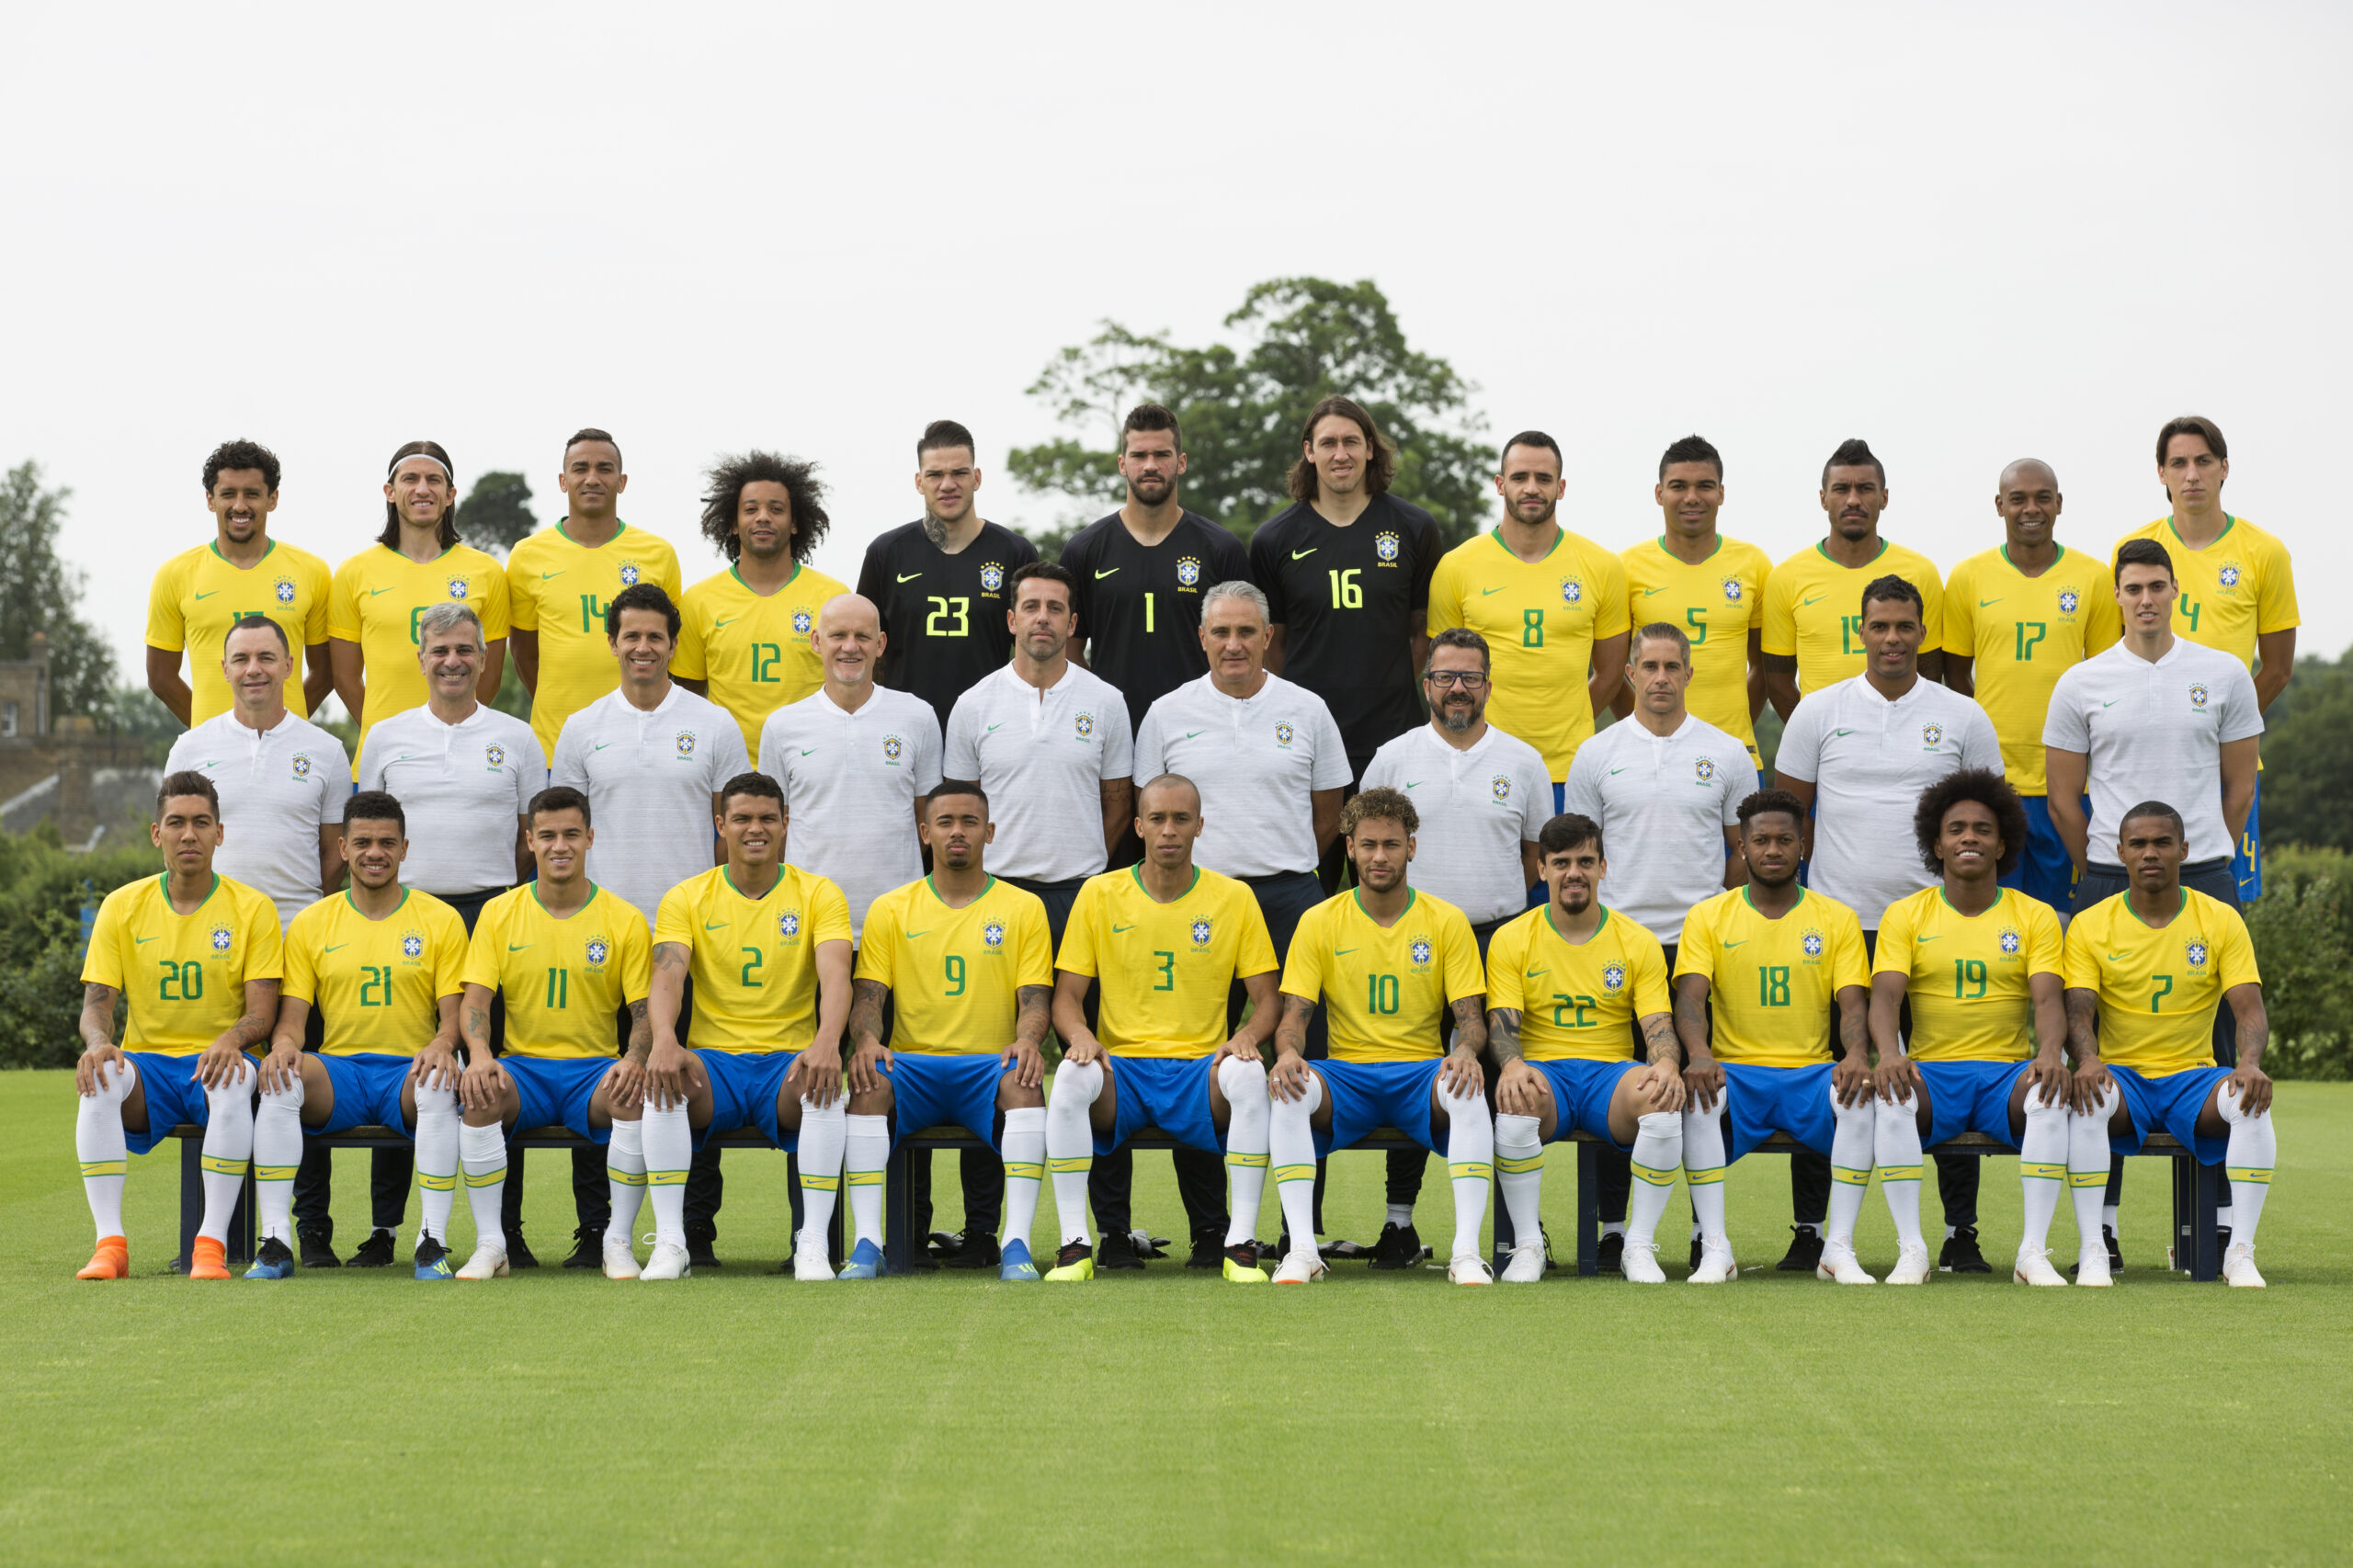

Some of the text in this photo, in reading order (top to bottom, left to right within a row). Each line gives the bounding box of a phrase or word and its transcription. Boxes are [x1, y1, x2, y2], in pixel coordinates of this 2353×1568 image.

[1329, 569, 1362, 608] 16
[580, 595, 609, 632] 14
[926, 597, 969, 636] 23
[1145, 593, 1154, 632] 1
[1524, 609, 1543, 647] 8
[1688, 608, 1706, 644] 5
[2180, 594, 2200, 631] 4
[2017, 622, 2045, 660] 17
[752, 643, 780, 682] 12
[2243, 833, 2256, 872] 4
[160, 961, 202, 1000] 20
[360, 967, 392, 1006] 21
[742, 948, 762, 986] 2
[946, 956, 965, 995] 9
[1154, 951, 1174, 991] 3
[1759, 966, 1790, 1006] 18
[1955, 960, 1986, 998] 19
[547, 968, 567, 1008] 11
[1369, 974, 1399, 1015] 10
[2152, 975, 2172, 1013] 7
[1553, 994, 1597, 1027] 22
